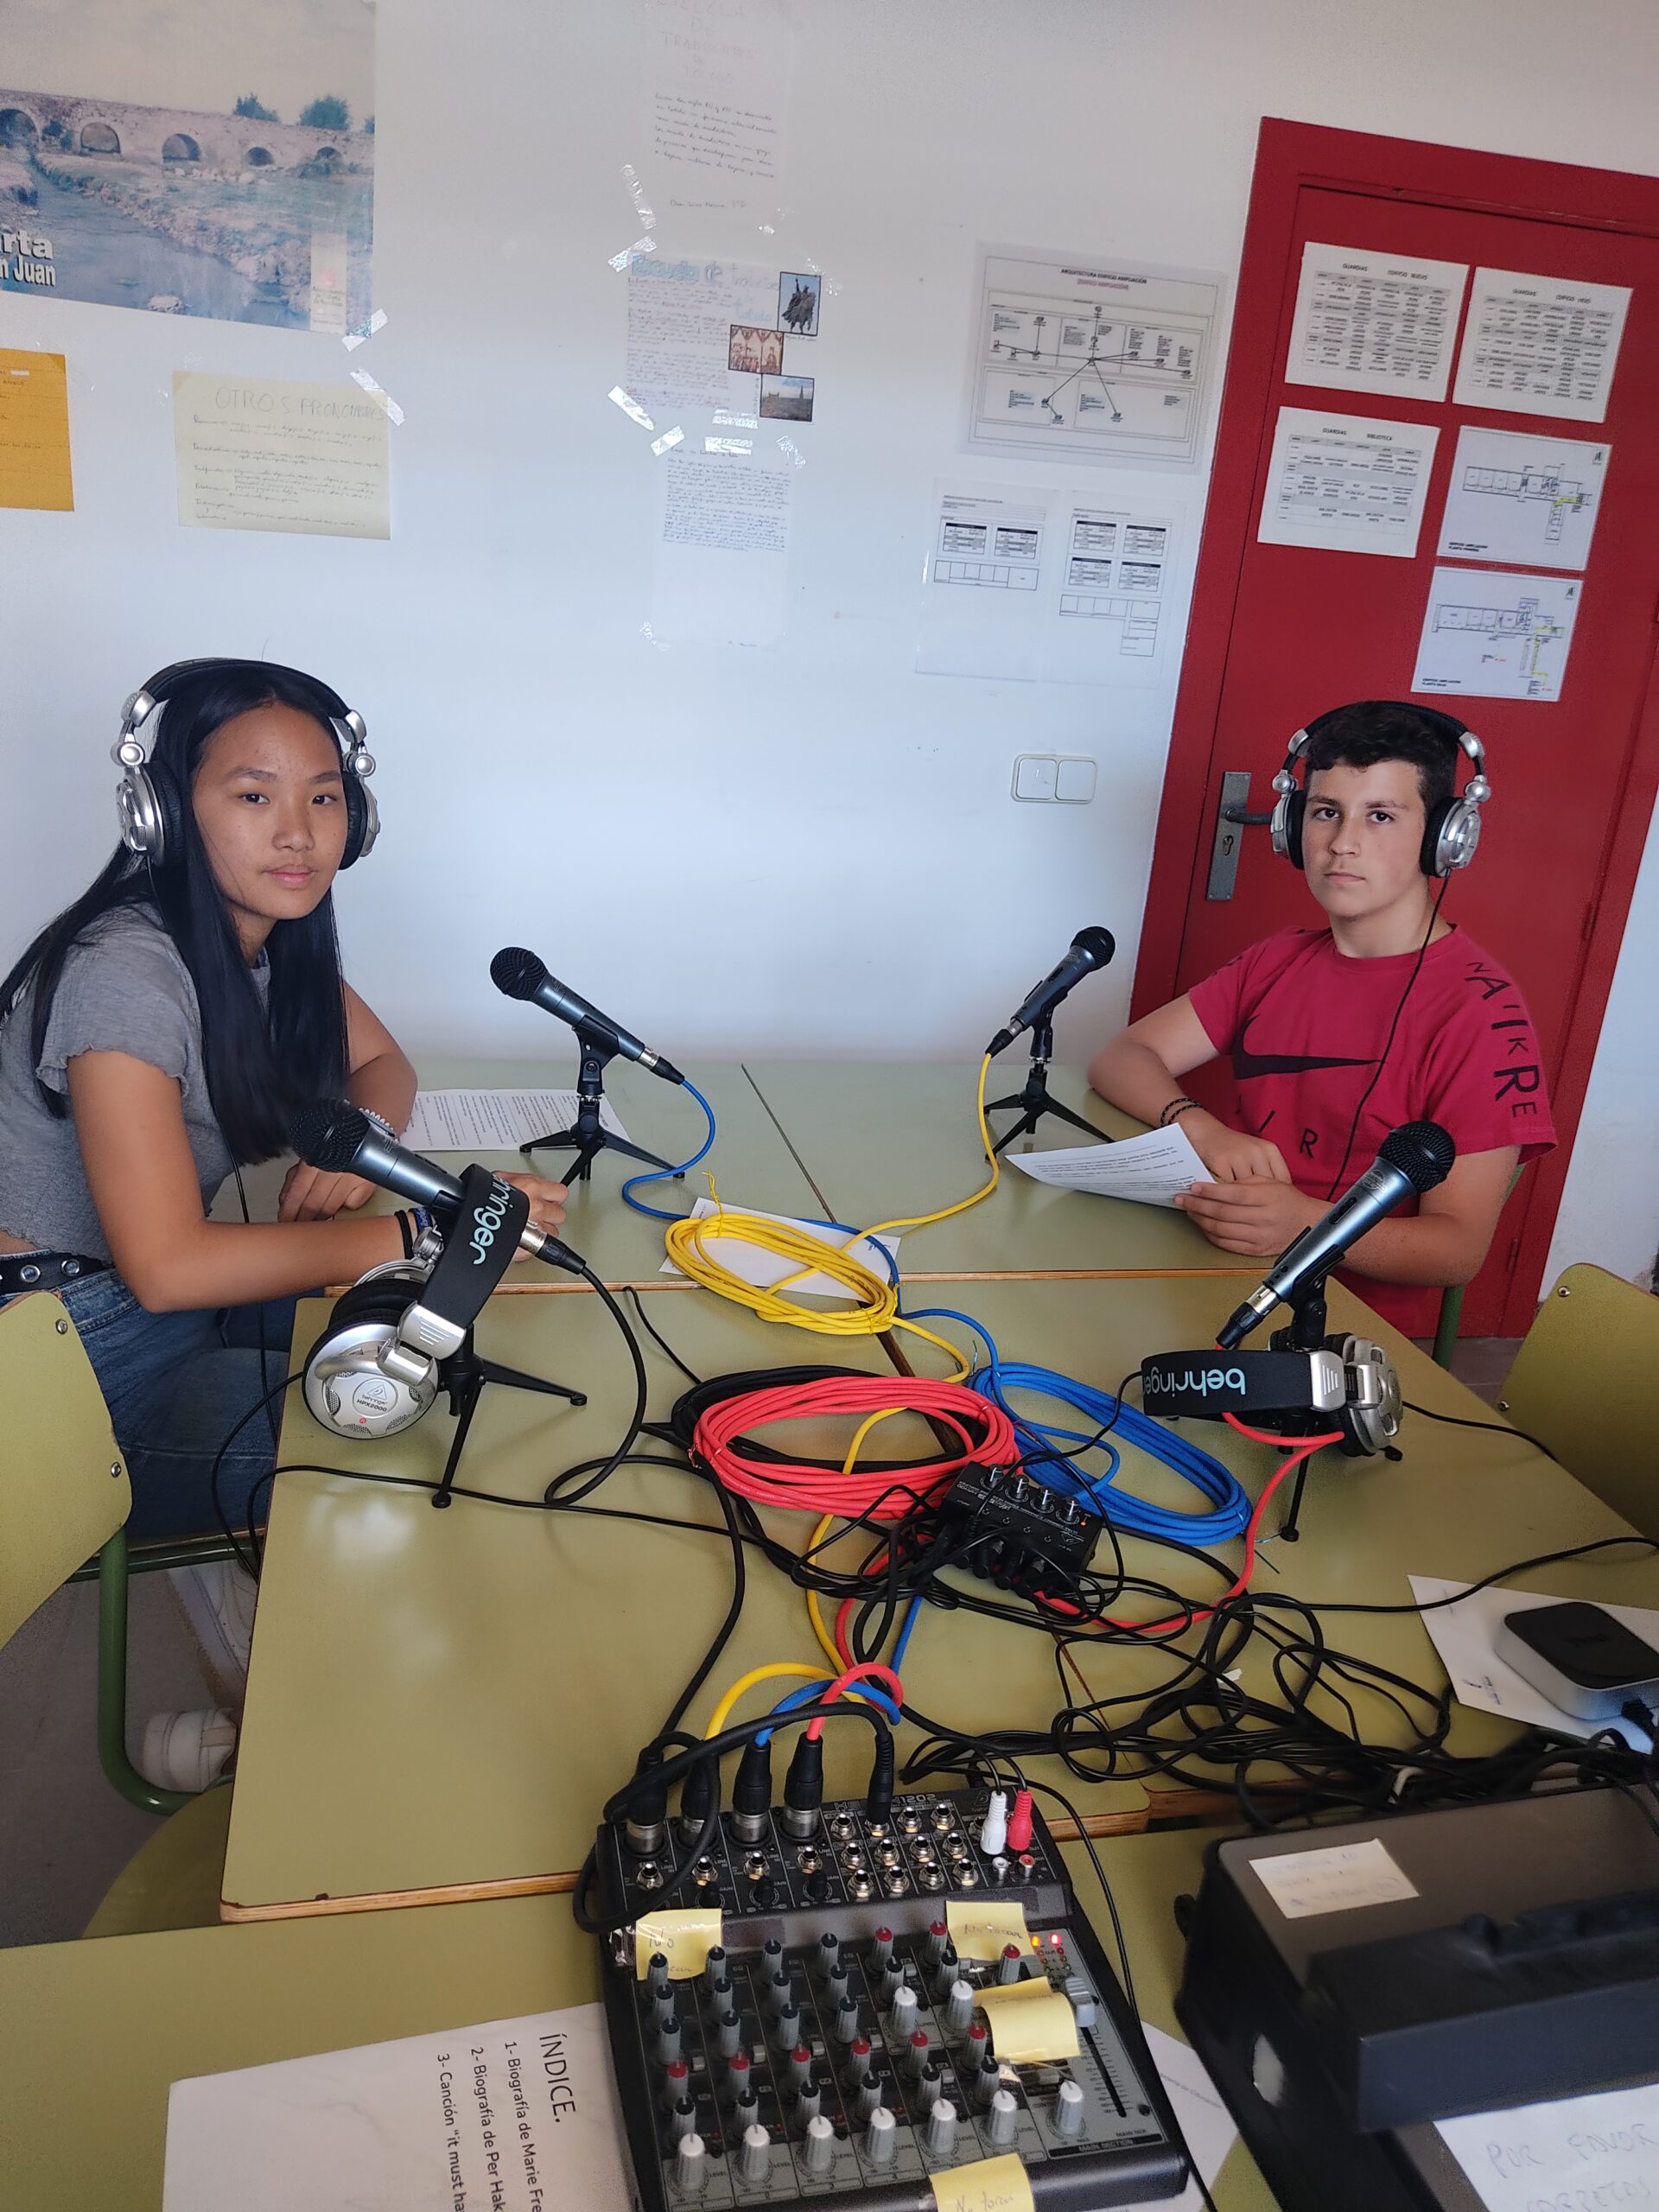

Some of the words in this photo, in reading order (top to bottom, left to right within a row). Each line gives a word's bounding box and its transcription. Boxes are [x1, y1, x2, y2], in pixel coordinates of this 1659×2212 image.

[1, 230, 53, 260] rta
[13, 254, 55, 286] Juan
[1367, 433, 1393, 442] BIBLIOTECA
[356, 1399, 388, 1412] HPX2000
[362, 1395, 388, 1405] behringer
[900, 1793, 937, 1804] 1202
[471, 2046, 484, 2062] 2-
[505, 2041, 517, 2055] 1-
[437, 2053, 450, 2067] 3-
[507, 2057, 531, 2119] Biografía
[539, 2032, 576, 2123] ÍNDICE.
[439, 2071, 459, 2126] Canción
[474, 2063, 498, 2127] Biografía
[483, 2130, 497, 2149] de
[518, 2121, 530, 2140] de
[448, 2151, 464, 2190] must
[486, 2151, 499, 2177] Per
[522, 2143, 537, 2185] Marie
